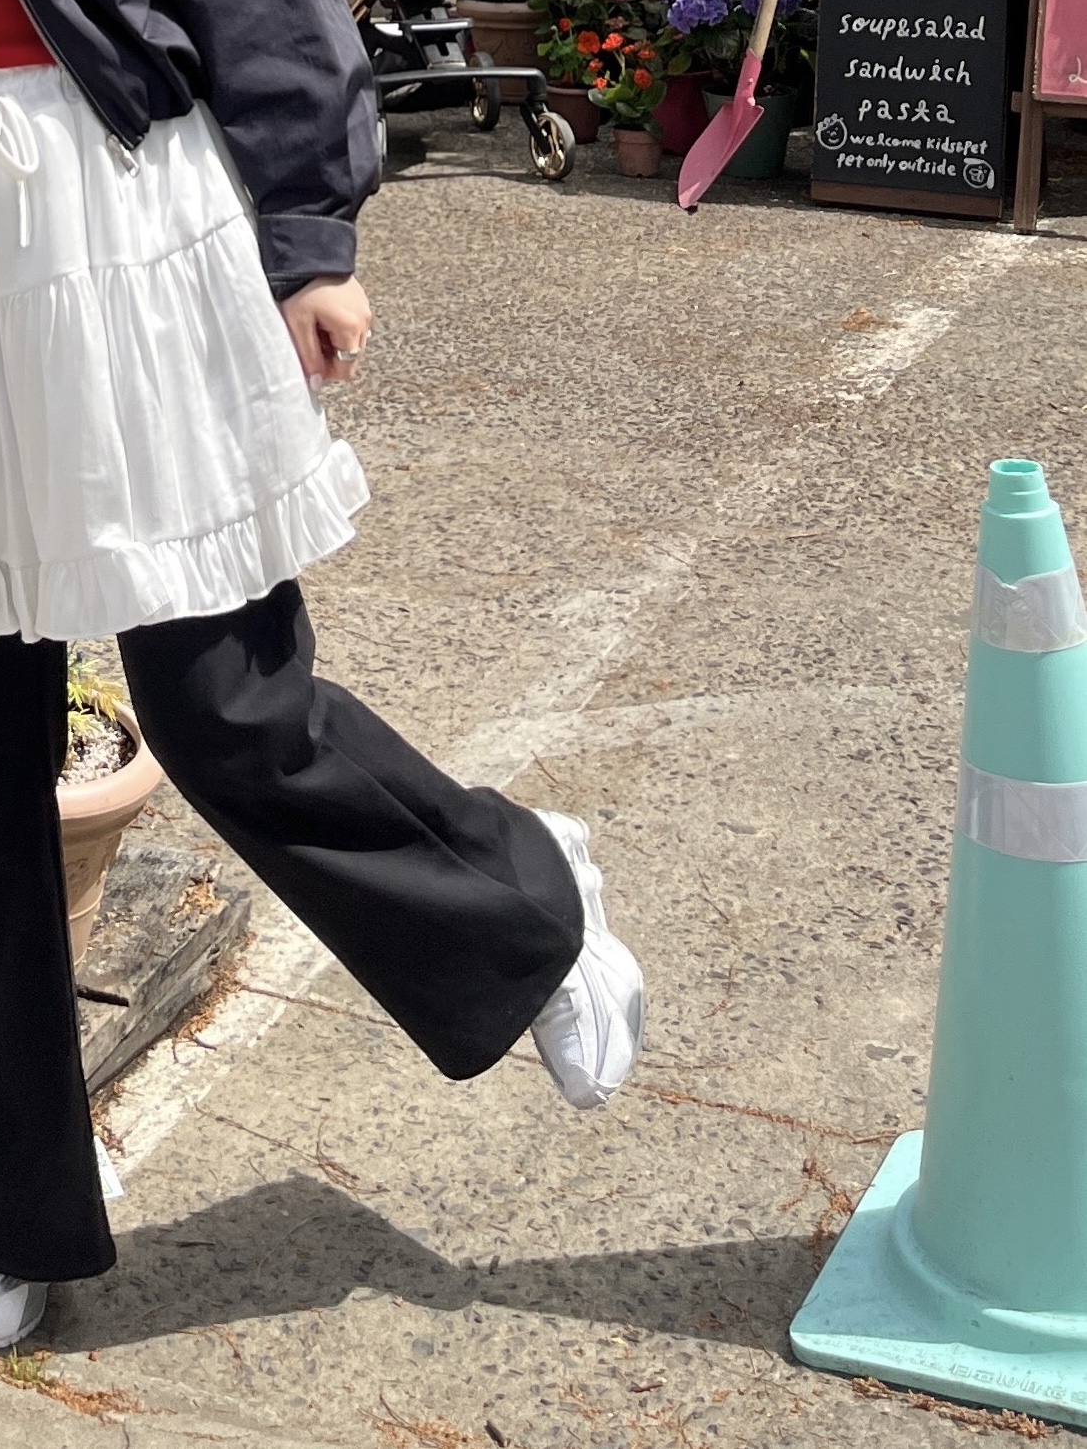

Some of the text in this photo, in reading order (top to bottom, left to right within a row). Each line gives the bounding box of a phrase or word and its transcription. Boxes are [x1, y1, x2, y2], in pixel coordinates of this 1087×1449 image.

[838, 13, 987, 41] soup&salad
[843, 55, 972, 86] sandwich
[849, 132, 922, 150] welcome
[866, 153, 896, 175] only
[898, 155, 957, 177] outside
